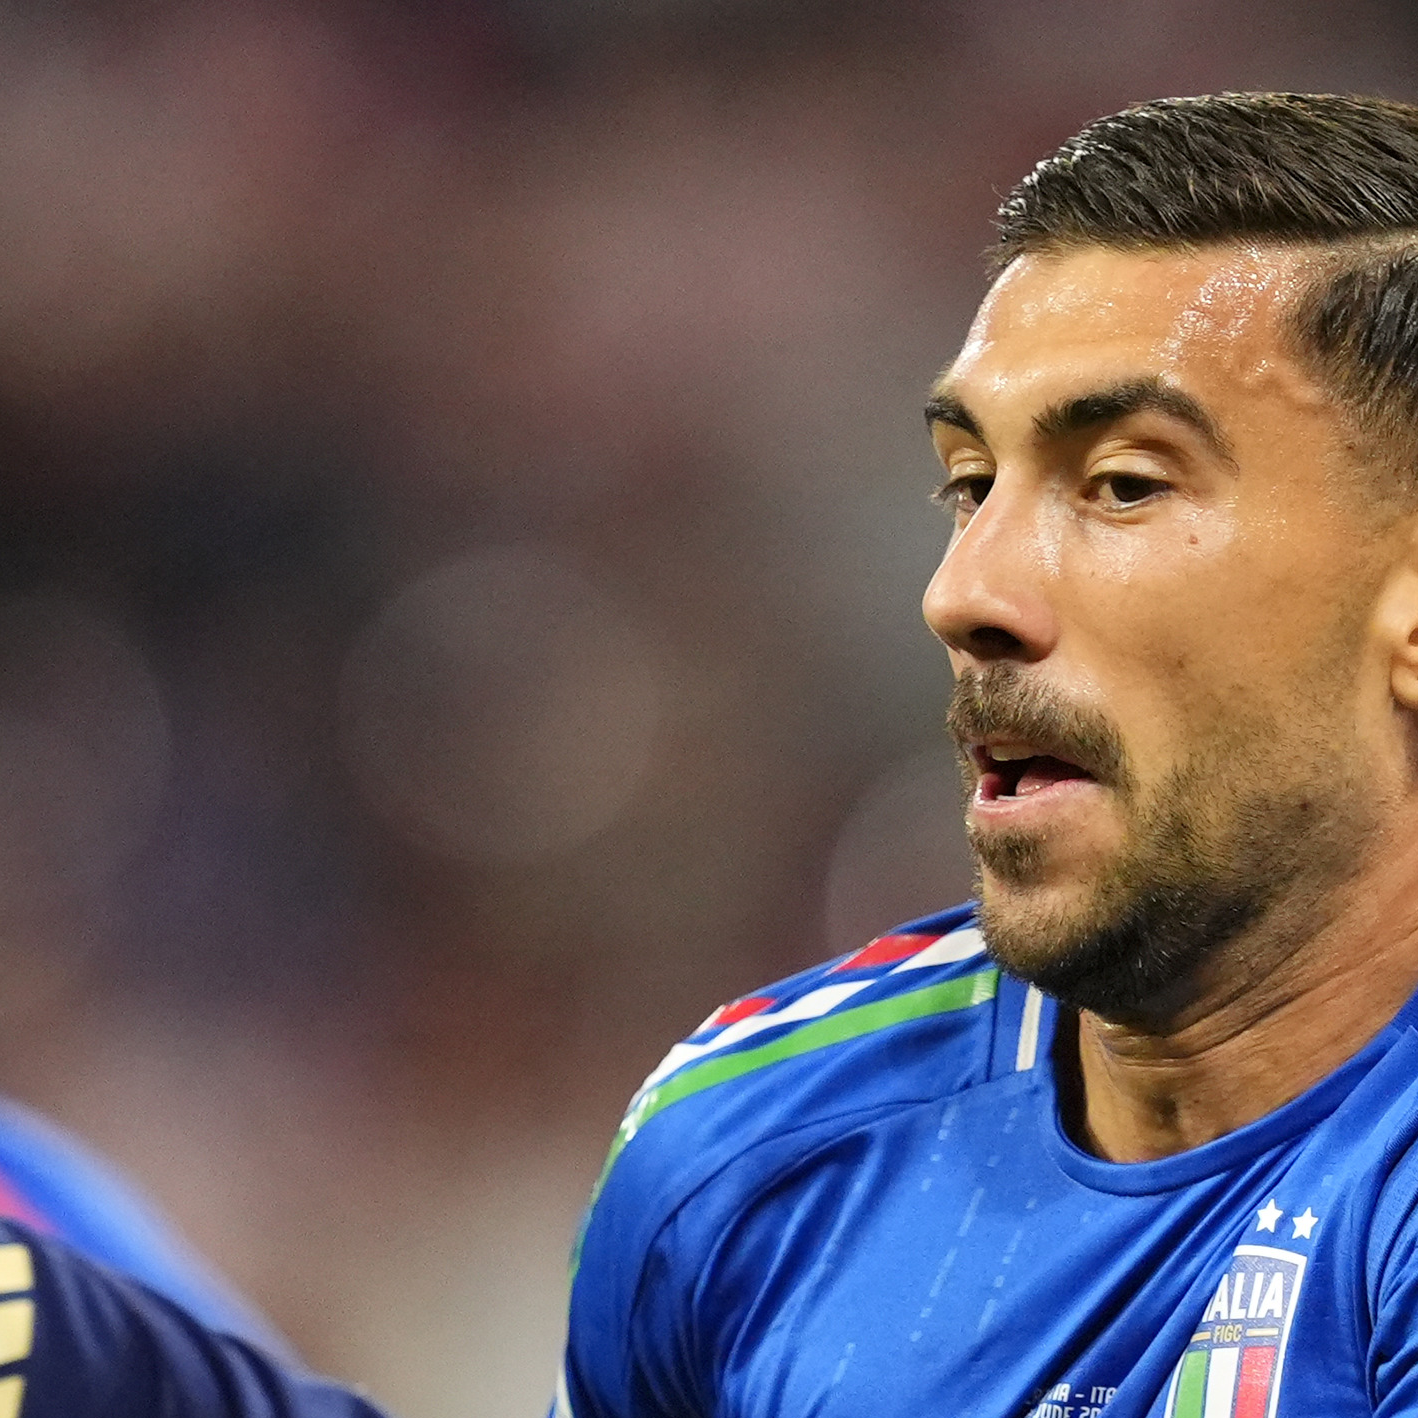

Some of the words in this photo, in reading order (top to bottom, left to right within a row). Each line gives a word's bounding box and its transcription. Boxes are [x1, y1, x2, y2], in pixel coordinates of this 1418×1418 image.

[1202, 1271, 1284, 1323] ALIA
[1212, 1324, 1243, 1344] FIGC
[1089, 1385, 1118, 1405] ITA
